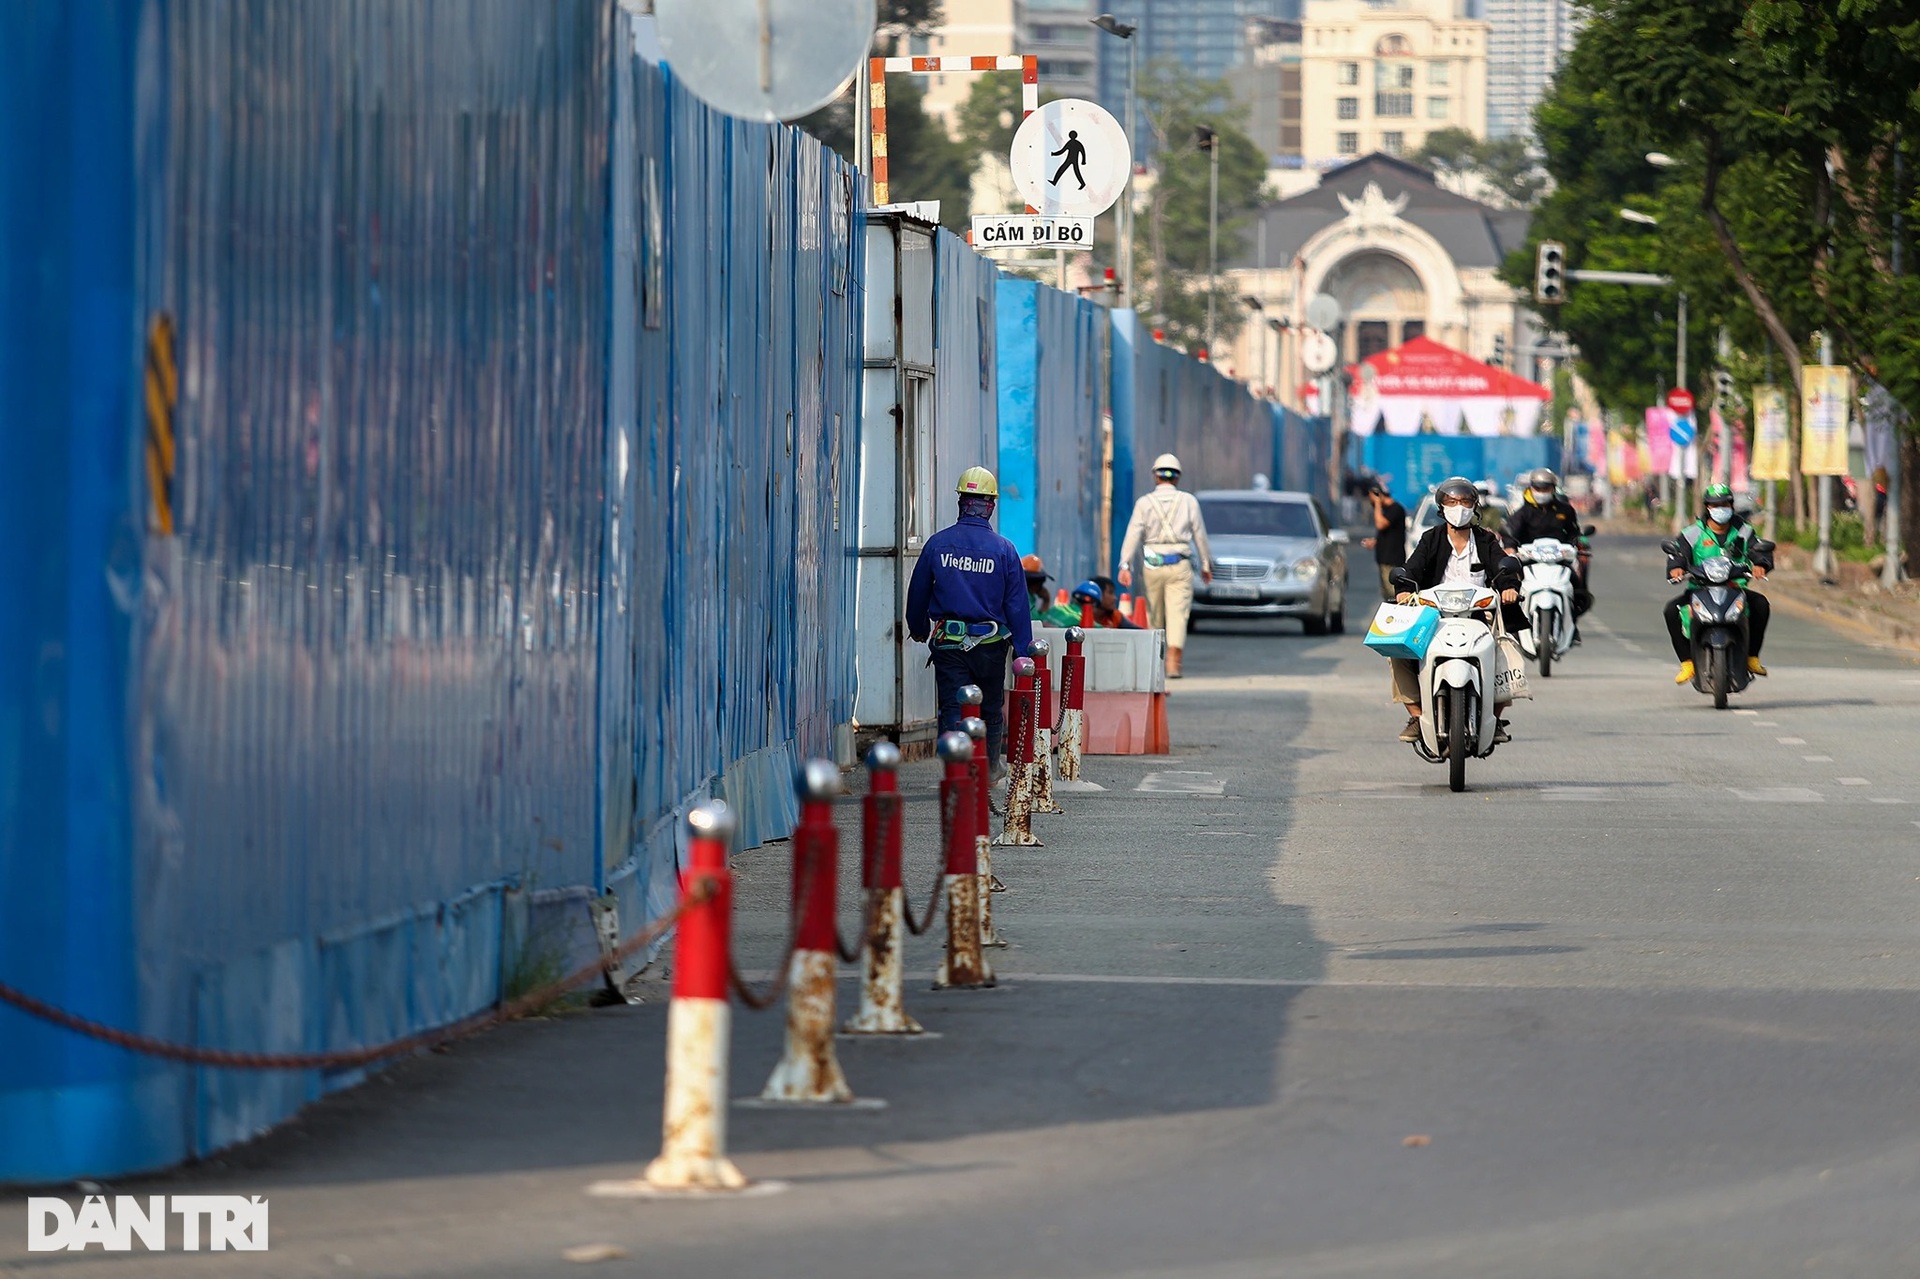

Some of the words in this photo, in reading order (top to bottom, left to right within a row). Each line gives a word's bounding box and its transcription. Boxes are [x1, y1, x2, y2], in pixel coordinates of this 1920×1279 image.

[983, 220, 1024, 241] CẤM
[1032, 226, 1051, 241] ĐI
[940, 552, 995, 574] VietBuilD
